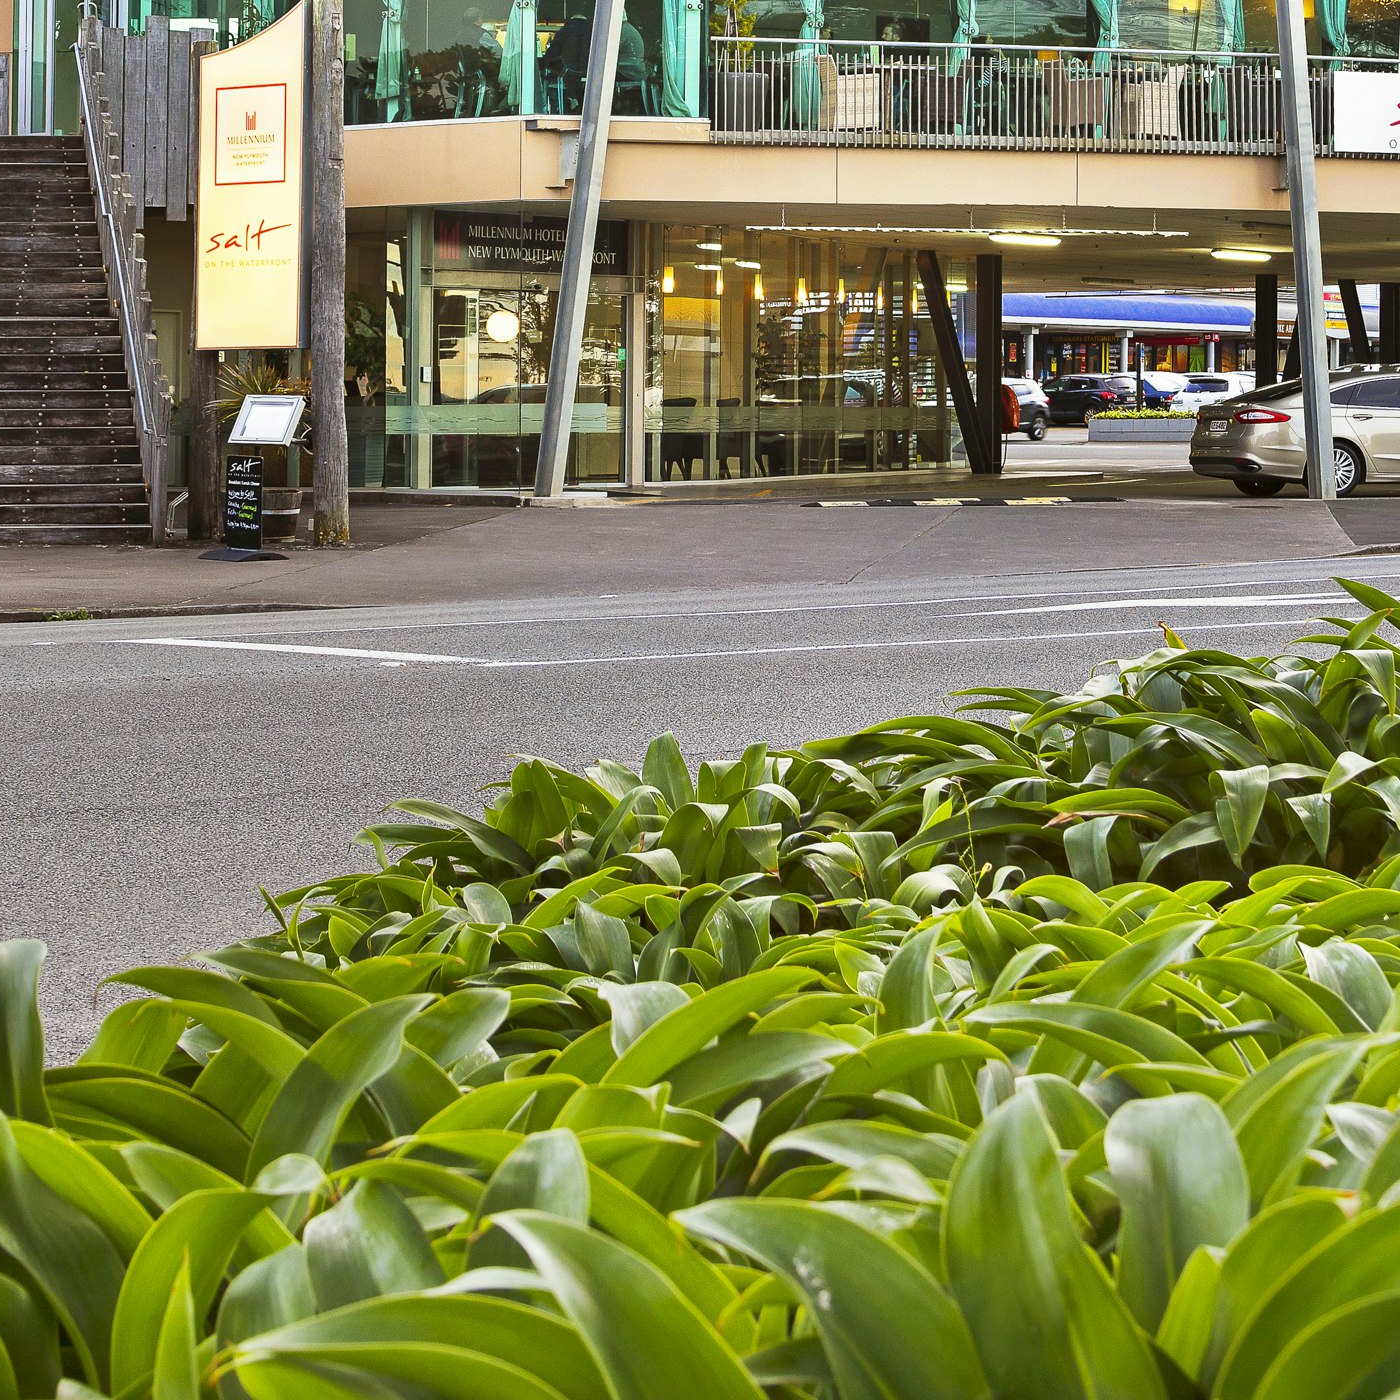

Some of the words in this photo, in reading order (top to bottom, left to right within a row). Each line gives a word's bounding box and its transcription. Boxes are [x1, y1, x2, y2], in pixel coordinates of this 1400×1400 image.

[227, 134, 275, 145] MILLENNIUM
[205, 219, 292, 254] salt
[468, 225, 533, 241] MILLENNIUM
[468, 245, 491, 259] NEW
[494, 247, 550, 261] PLYMOUTH
[239, 258, 292, 266] WATERFRONT
[229, 458, 261, 472] salt
